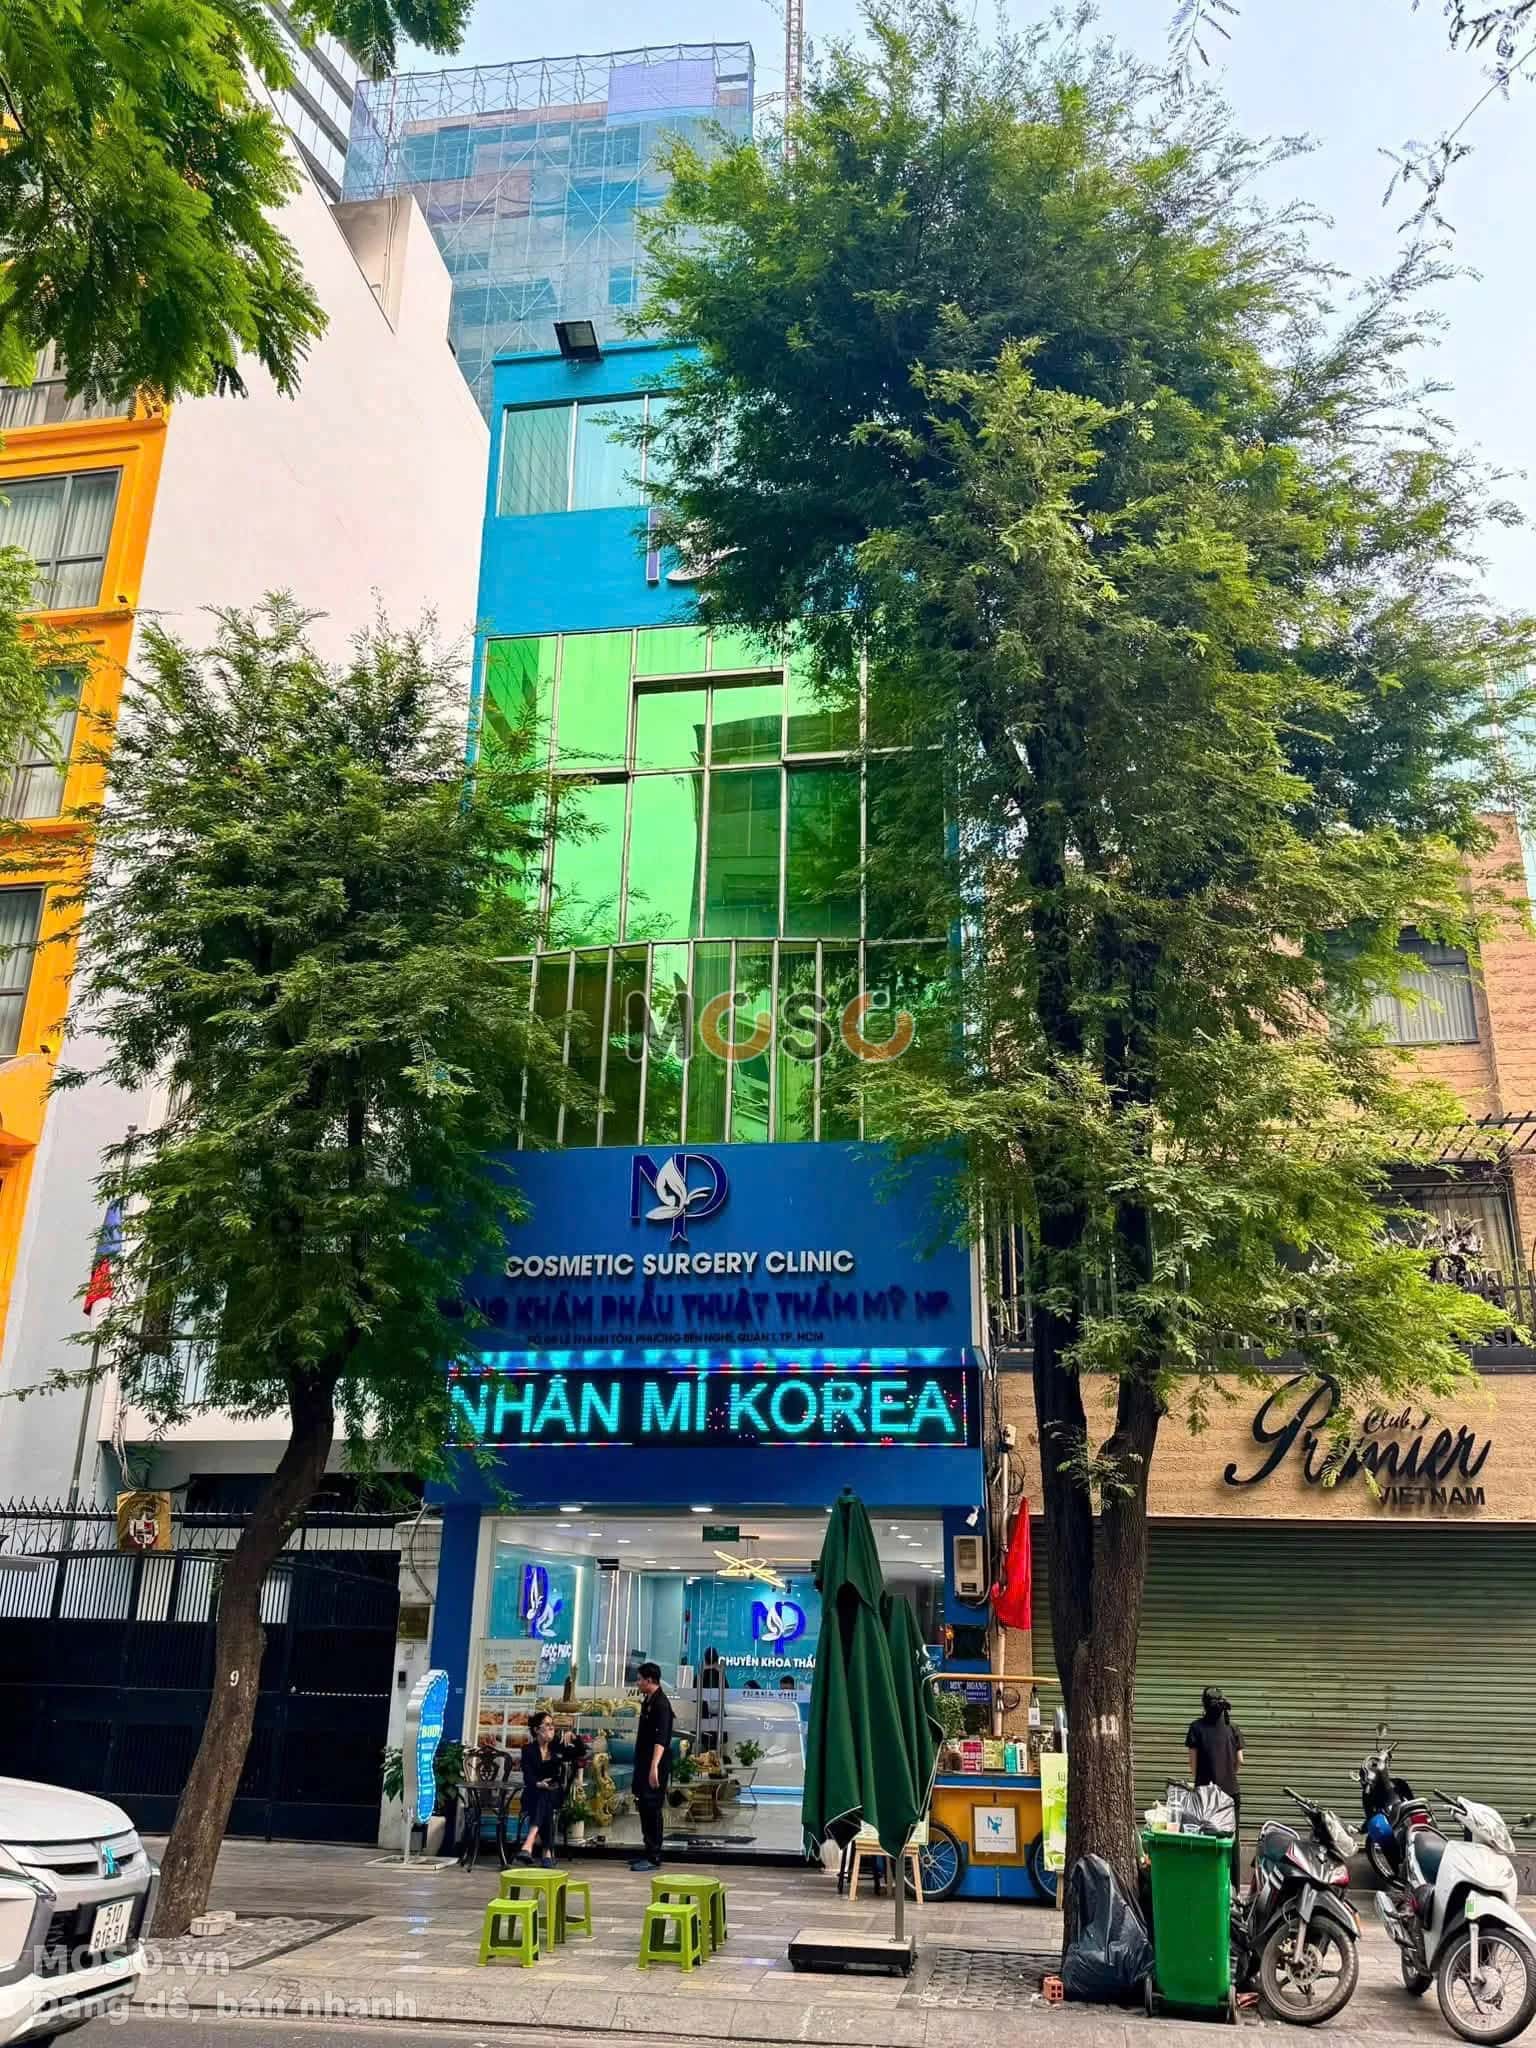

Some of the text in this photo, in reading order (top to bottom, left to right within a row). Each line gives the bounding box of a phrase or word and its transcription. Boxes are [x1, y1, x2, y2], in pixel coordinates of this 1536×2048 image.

[504, 1249, 855, 1278] COSMETIC SURGERY CLINIC
[450, 1374, 620, 1433] NHÂN
[730, 1379, 956, 1433] KOREA
[1379, 1486, 1486, 1506] VIETNAM
[761, 1658, 792, 1668] KHOA
[230, 1670, 240, 1686] 9
